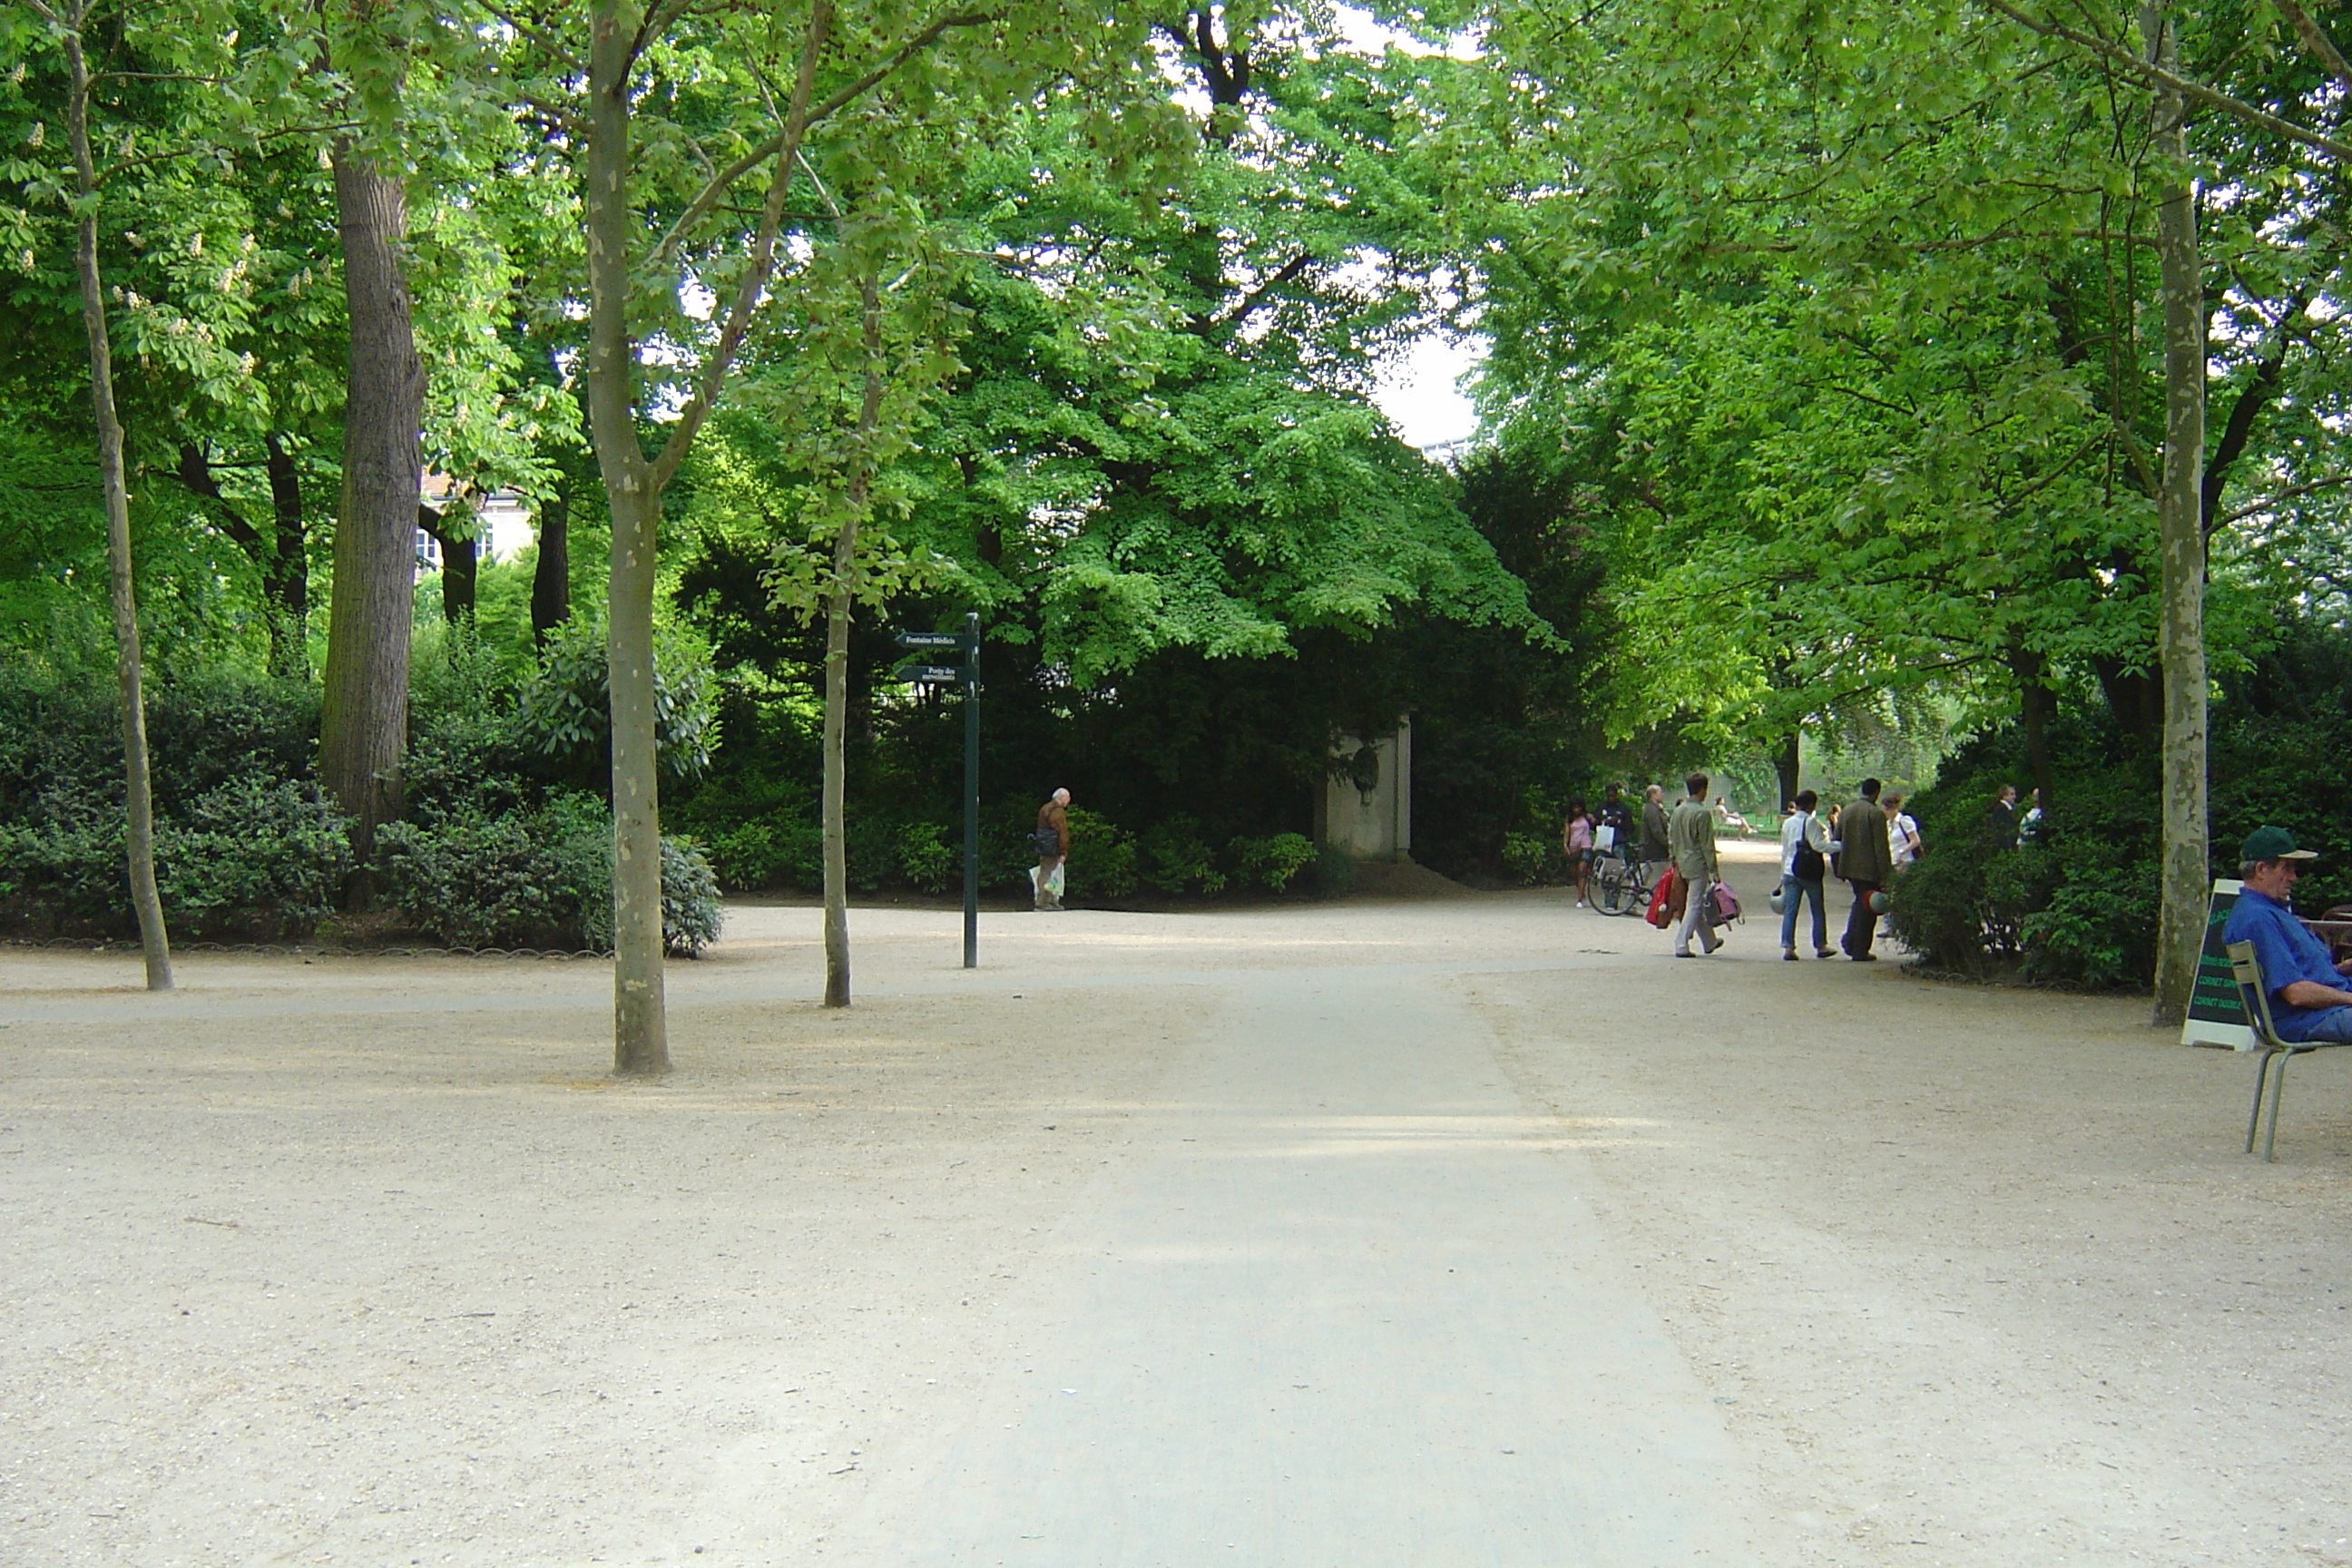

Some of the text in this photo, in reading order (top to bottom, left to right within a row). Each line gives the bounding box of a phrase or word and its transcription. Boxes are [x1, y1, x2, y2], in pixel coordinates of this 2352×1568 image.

[906, 636, 932, 644] Fontaine
[2198, 975, 2222, 987] CORNET
[2193, 995, 2219, 1007] CORNET
